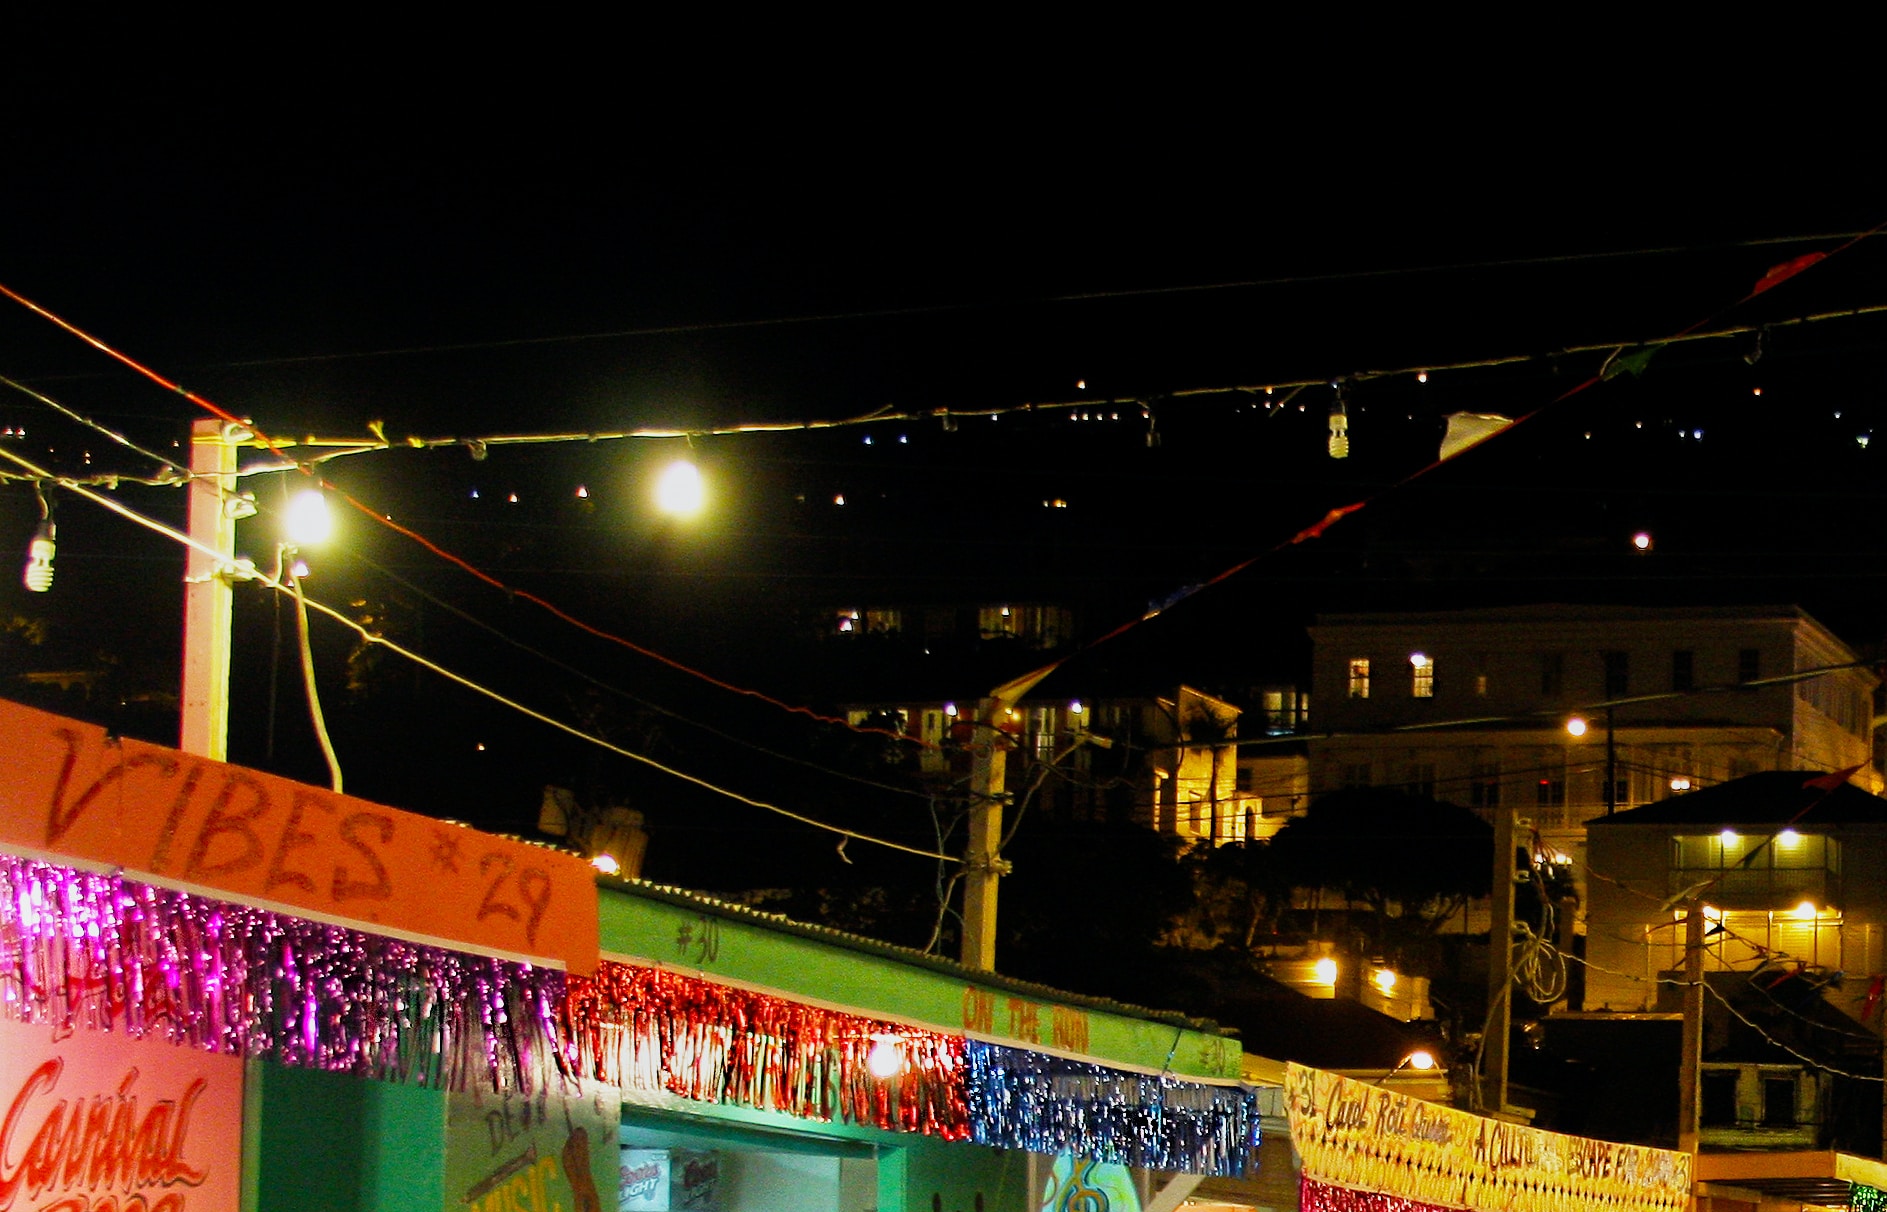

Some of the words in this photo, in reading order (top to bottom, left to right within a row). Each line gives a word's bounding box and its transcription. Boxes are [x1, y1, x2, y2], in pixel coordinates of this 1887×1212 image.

[45, 728, 394, 902] VIBES
[676, 915, 719, 964] #30
[963, 985, 994, 1035] ON
[1007, 997, 1040, 1044] THE
[1052, 1004, 1090, 1055] RUN
[0, 1056, 210, 1212] Carnival
[1473, 1119, 1488, 1163] A
